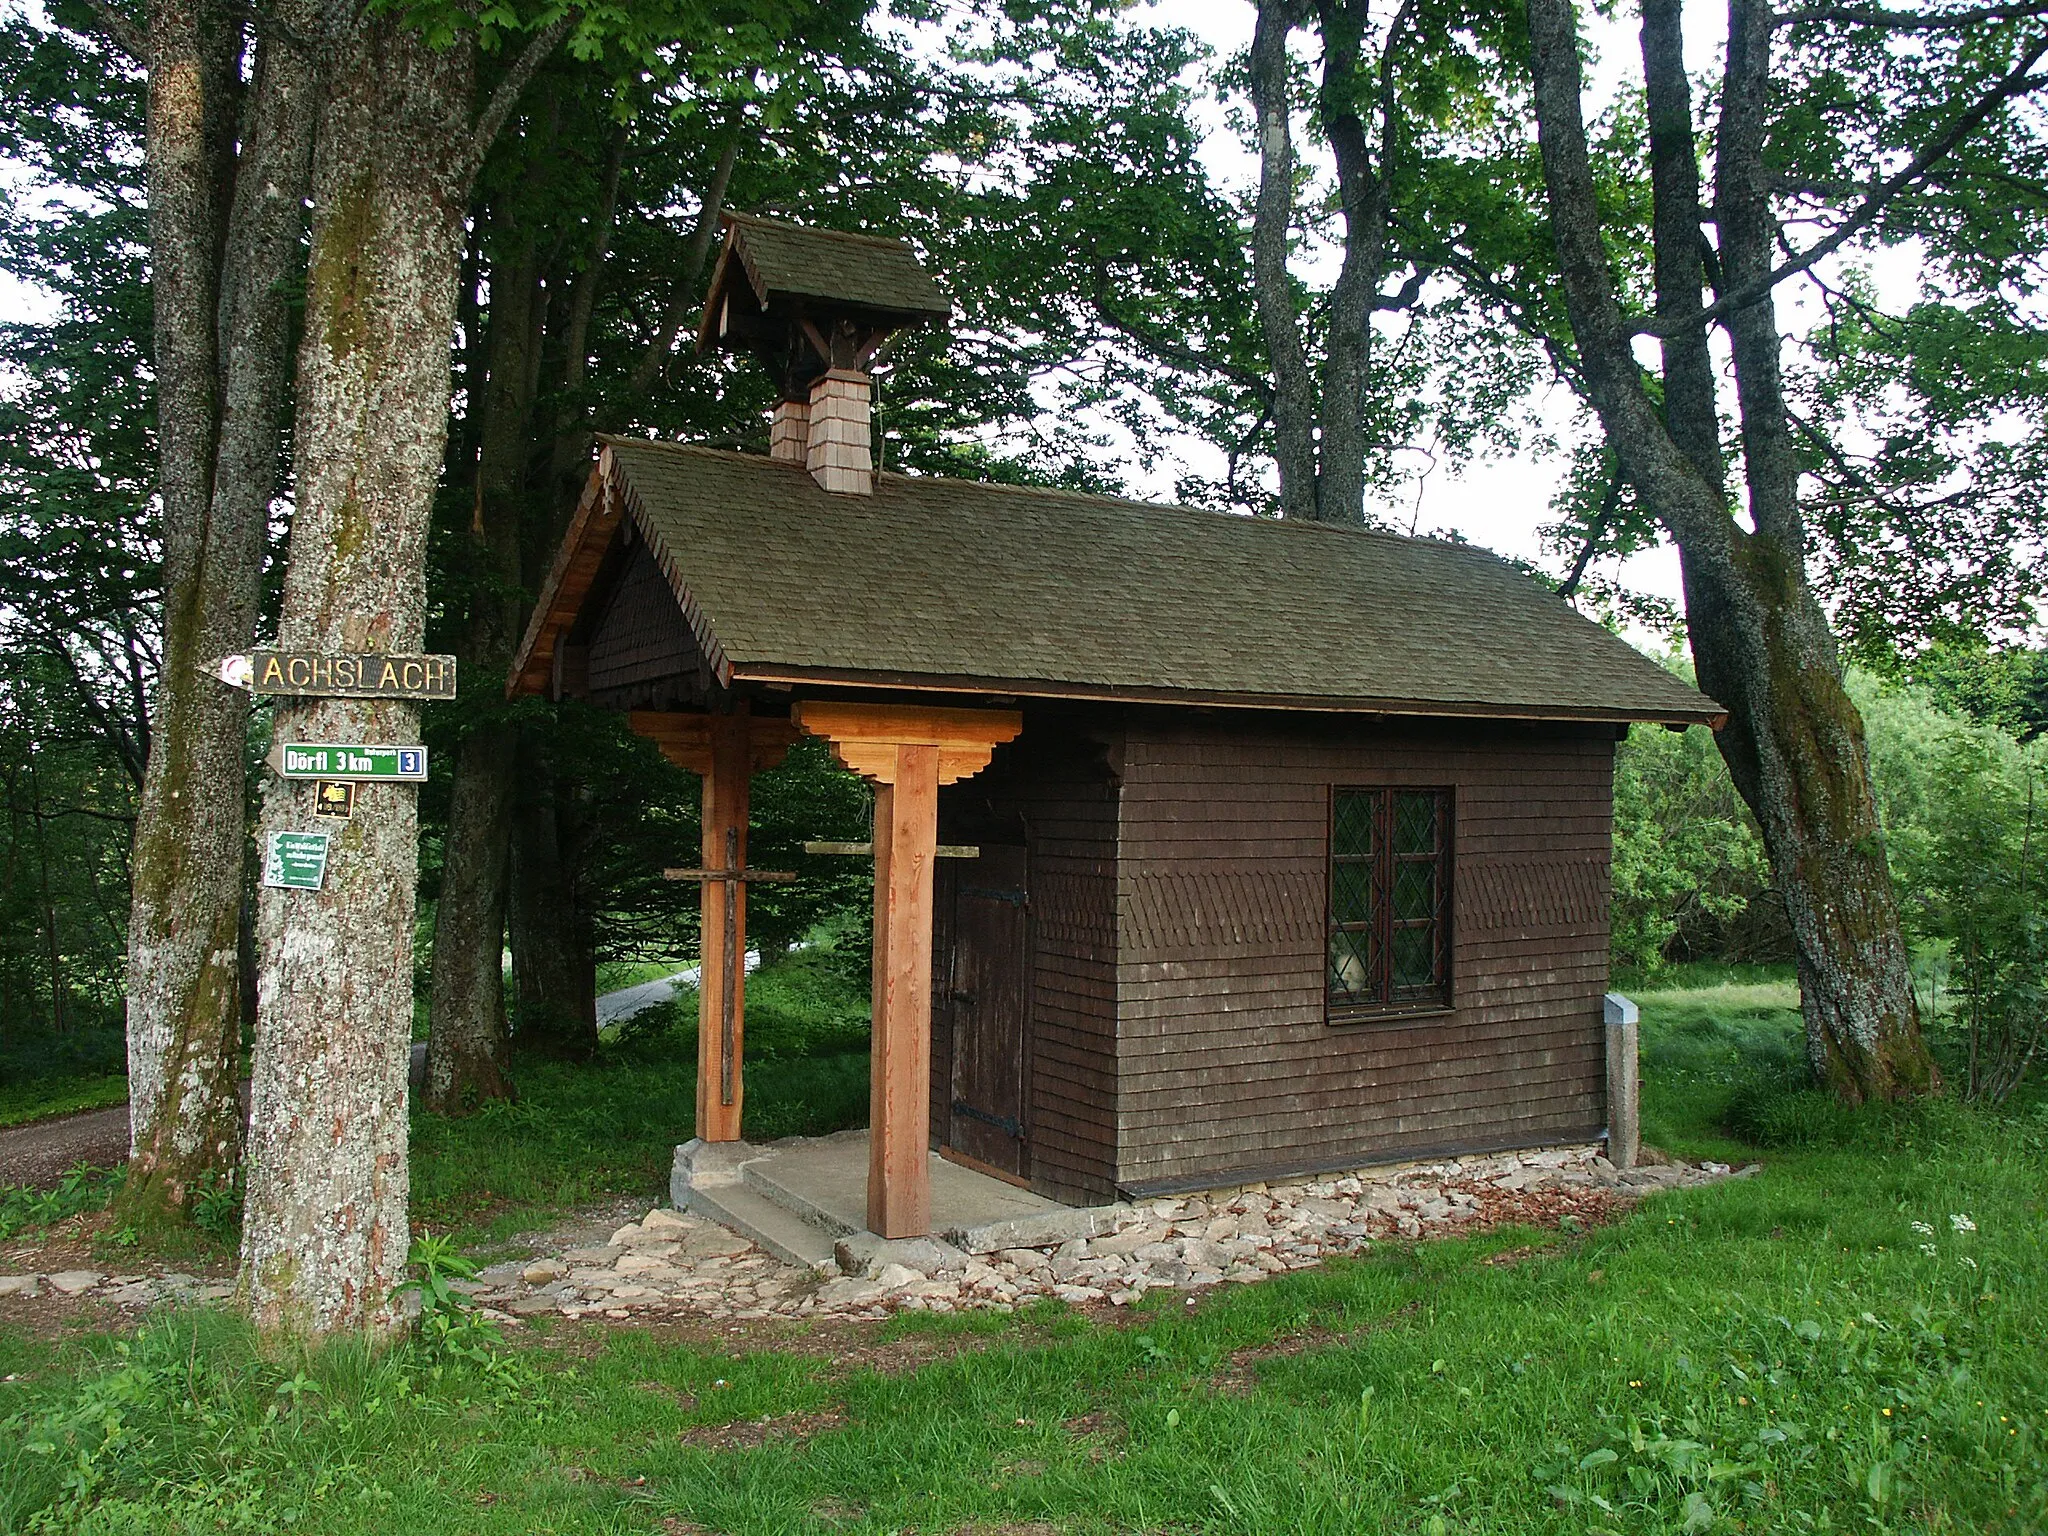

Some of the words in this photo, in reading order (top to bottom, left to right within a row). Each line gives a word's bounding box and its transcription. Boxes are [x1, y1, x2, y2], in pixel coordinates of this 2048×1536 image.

[263, 657, 444, 691] ACHSLACH
[287, 750, 328, 771] Dörfl
[405, 752, 415, 772] 3
